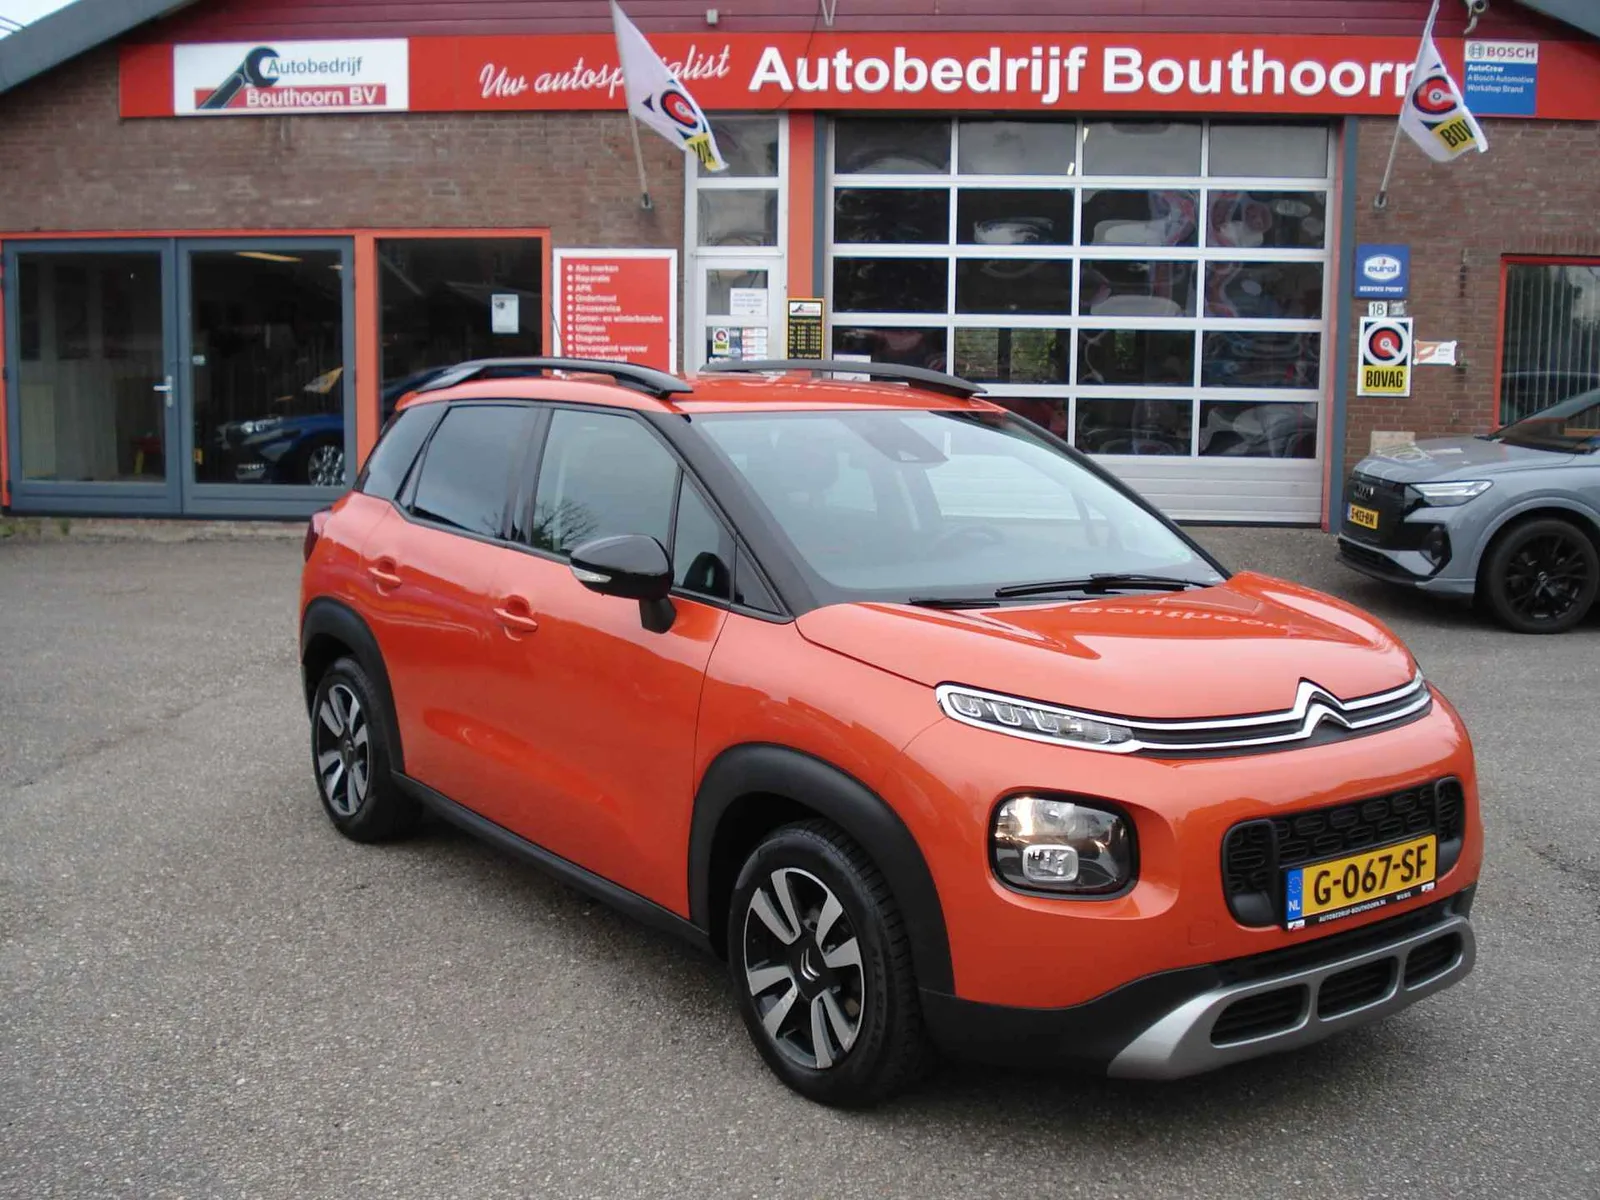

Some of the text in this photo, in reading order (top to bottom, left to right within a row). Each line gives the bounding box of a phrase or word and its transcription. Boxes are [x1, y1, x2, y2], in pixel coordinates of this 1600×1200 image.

[1487, 46, 1535, 58] BOSCH
[267, 56, 363, 77] Autobedrijf
[479, 44, 731, 99] Uw autospalist
[747, 46, 1088, 104] Autobedrijf
[1468, 64, 1504, 72] AutoCrew
[1467, 84, 1524, 93] Workshop Brand
[1496, 75, 1535, 83] Automotive
[246, 86, 379, 108] Bouthoorn BV
[1440, 119, 1475, 148] BOV
[1370, 303, 1385, 316] 18
[1365, 369, 1403, 388] BOVAG
[1313, 843, 1429, 906] G-067-SF
[1288, 900, 1301, 912] NL
